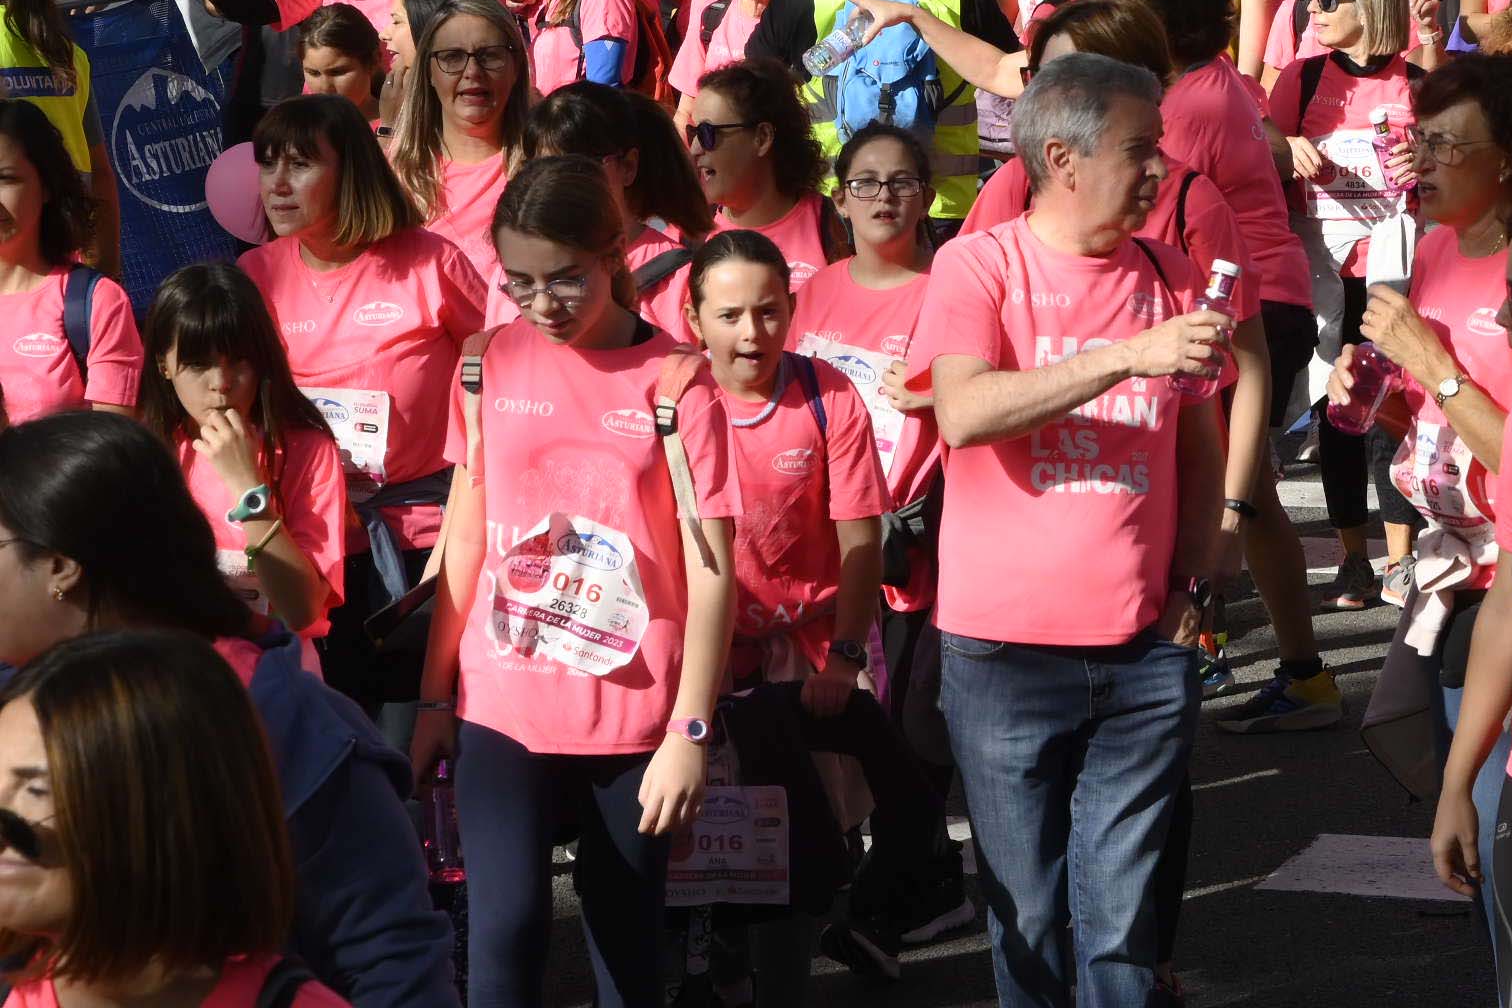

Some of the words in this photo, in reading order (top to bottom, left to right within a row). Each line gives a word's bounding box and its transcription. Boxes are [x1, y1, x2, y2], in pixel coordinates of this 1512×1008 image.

[125, 126, 223, 184] ASTURIAN
[1012, 287, 1072, 308] OSHO
[281, 319, 317, 334] SHO
[494, 397, 554, 418] OYSHO
[606, 416, 656, 434] ASTURIAN
[1030, 428, 1100, 460] LAS
[1030, 461, 1149, 495] CHICAS
[552, 571, 606, 604] 016
[549, 598, 589, 620] 26328
[571, 623, 603, 642] MUJER
[699, 834, 743, 851] 016
